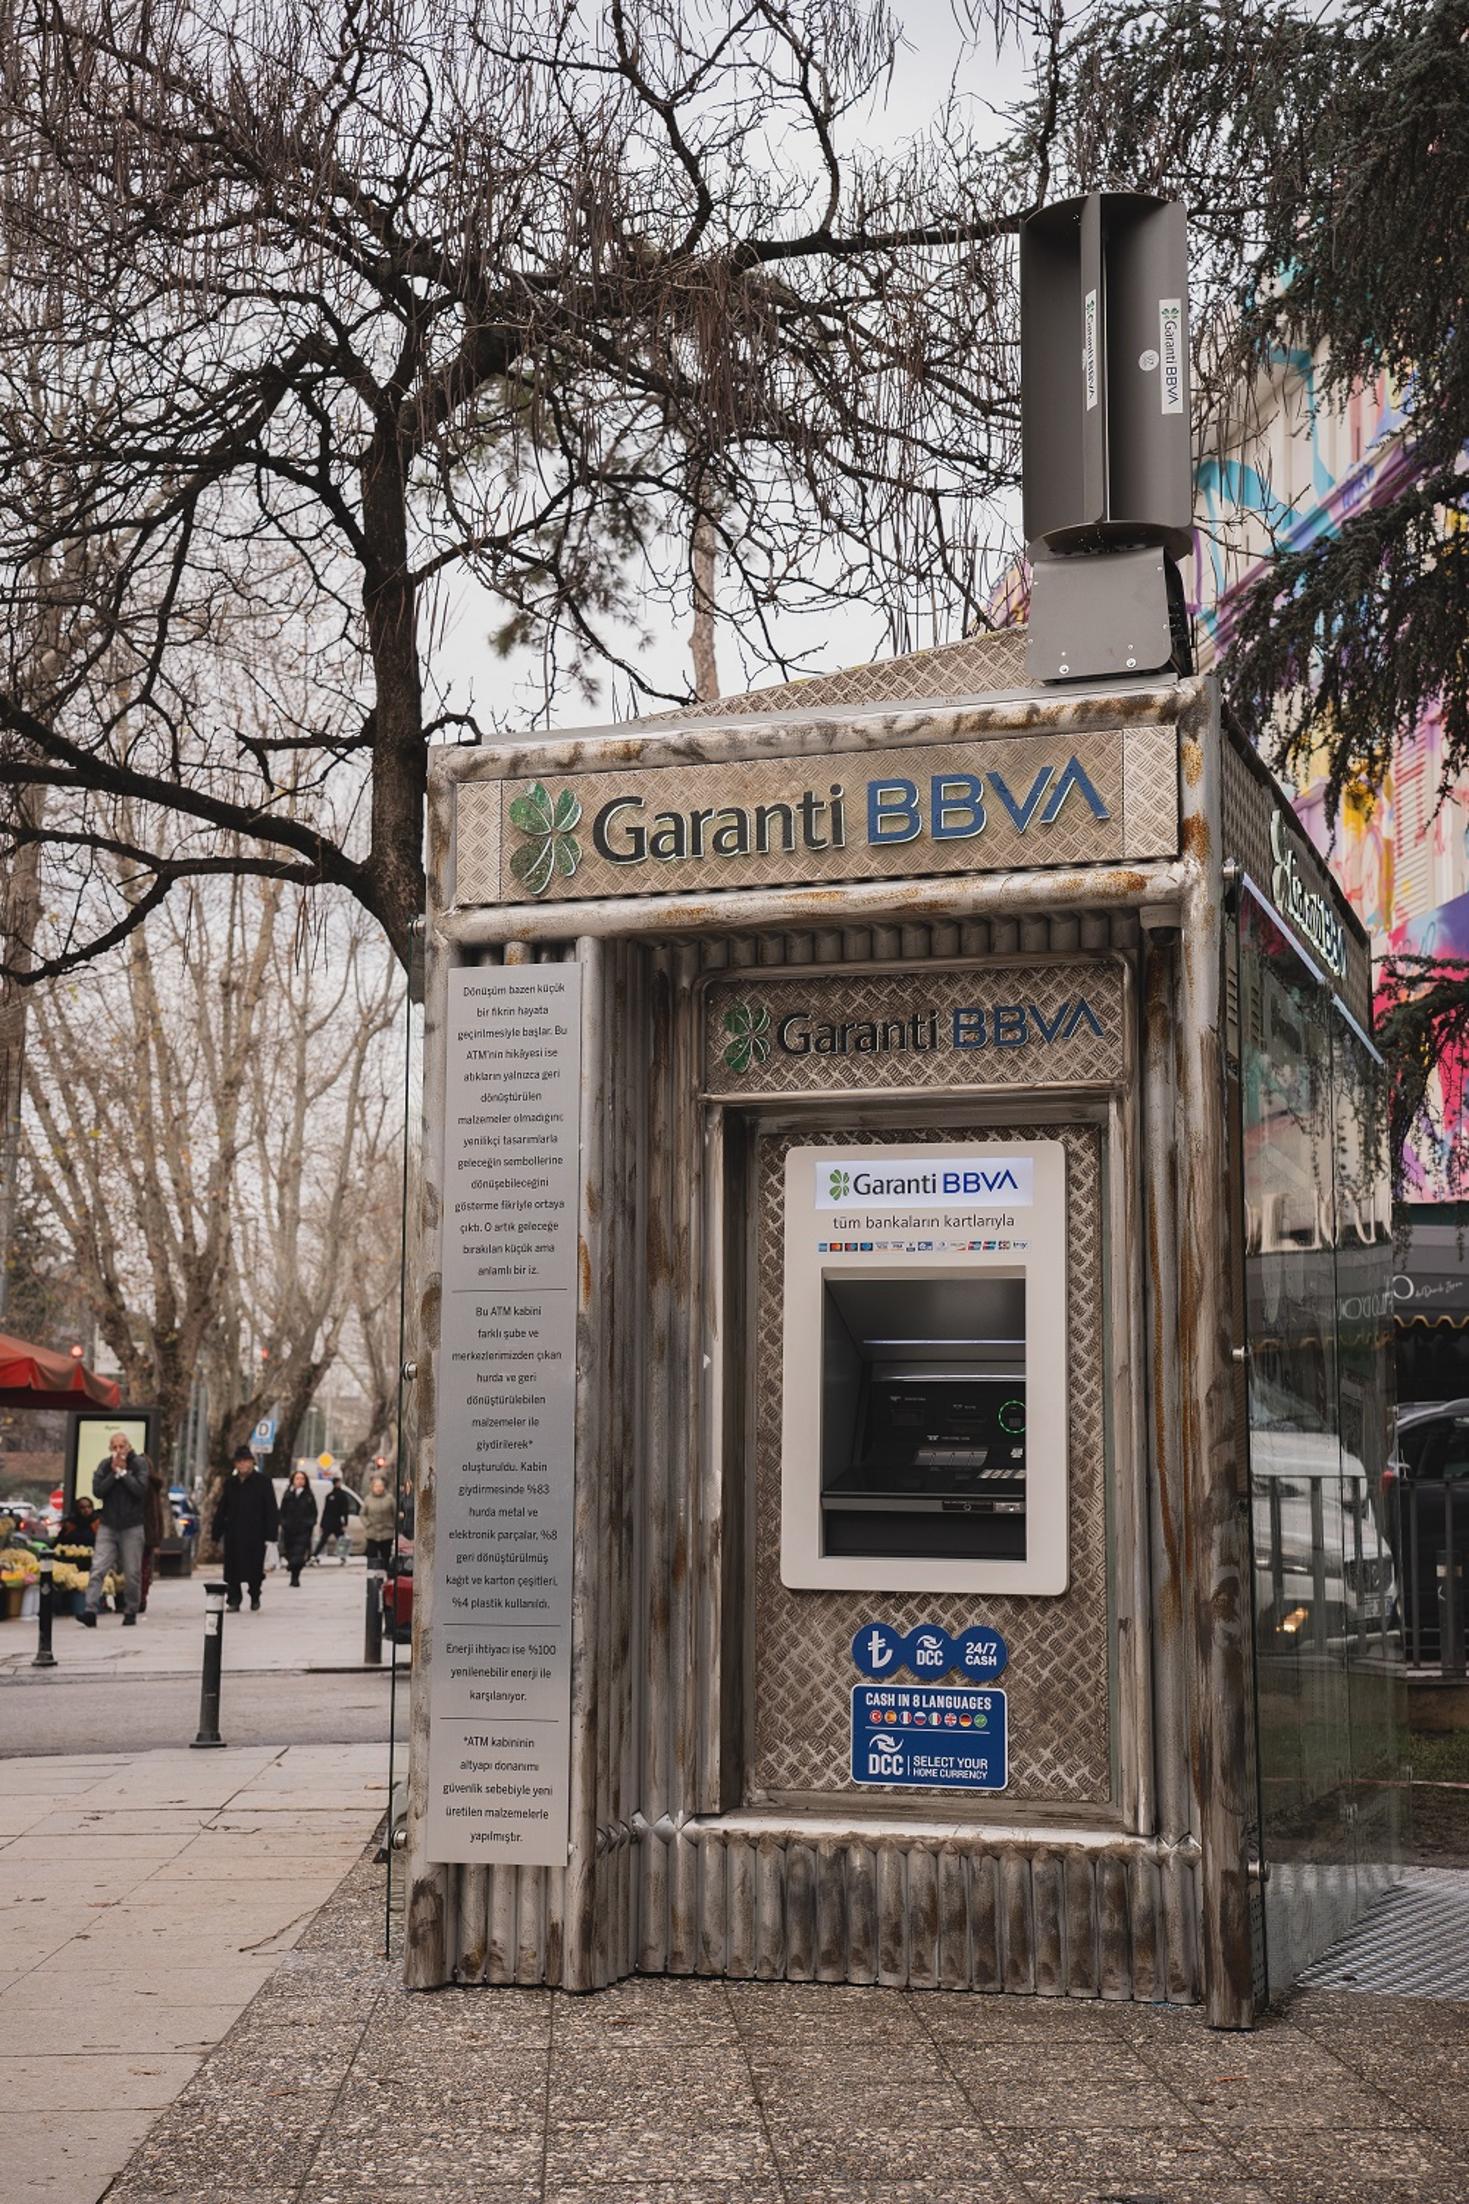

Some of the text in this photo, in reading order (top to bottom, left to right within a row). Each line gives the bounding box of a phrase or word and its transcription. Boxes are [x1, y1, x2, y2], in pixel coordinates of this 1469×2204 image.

[1164, 321, 1179, 404] Garanti BBVA
[592, 755, 1110, 865] Garanti BBVA
[464, 983, 564, 997] Dönüşüm bazen küçük
[477, 1008, 489, 1017] bir
[518, 1006, 548, 1017] hayata
[555, 1025, 567, 1035] Bu
[777, 999, 1104, 1056] Garanti BBVA
[545, 1048, 558, 1057] ise
[542, 1069, 560, 1080] geri
[480, 1091, 542, 1103] dönüştürülen
[458, 1115, 511, 1124] malzemeler
[463, 1134, 558, 1147] yenilikçi tasarımlarla
[458, 1156, 563, 1170] geleceğin sembollerine
[471, 1177, 548, 1190] dönüşebileceğini
[853, 1169, 1019, 1195] Garanti BBVA
[455, 1200, 564, 1212] gösterme fikriyle ortaya
[485, 1222, 492, 1231] O
[494, 1222, 514, 1231] artık
[518, 1222, 559, 1233] geleceğe
[833, 1213, 1014, 1230] tüm bankaların kartlarıyla
[505, 1243, 532, 1255] küçük
[535, 1244, 554, 1252] ama
[478, 1266, 512, 1275] anlamlı
[514, 1265, 526, 1274] bir
[476, 1306, 541, 1316] Bu ATM kabini
[478, 1329, 539, 1340] farklı şube ve
[452, 1351, 561, 1362] merkezlerimizden çıkan
[477, 1373, 503, 1382] hurda
[518, 1372, 536, 1384] geri
[467, 1395, 545, 1406] dönüştürülebilen
[472, 1417, 539, 1427] malzemeler ile
[462, 1462, 547, 1473] oluşturuldu. Kabin
[458, 1484, 550, 1496] giydirmesinde %83
[469, 1507, 538, 1517] hurda metal ve
[449, 1530, 495, 1539] elektronik
[541, 1530, 557, 1540] %8
[456, 1553, 548, 1565] geri dönüştürülmüş
[484, 1575, 515, 1585] karton
[452, 1598, 550, 1609] %4 plastik kullanıldı.
[446, 1644, 556, 1656] Enerji ihtiyacı ise %100
[966, 1642, 997, 1654] 24/7
[916, 1650, 943, 1666] DCC
[965, 1655, 997, 1666] CASH
[451, 1667, 551, 1680] yenilenebilir enerji ile
[470, 1690, 527, 1703] karşılanıyor.
[866, 1692, 992, 1710] CASH IN 8 LANGUAGES
[491, 1737, 534, 1748] kabininin
[460, 1760, 539, 1772] altyapı donanımı
[868, 1754, 903, 1775] DCC
[913, 1756, 988, 1769] SELECT YOUR
[913, 1769, 988, 1779] HOME CURRENCY
[443, 1783, 552, 1797] güvenlik sebebiyle yeni
[446, 1806, 549, 1819] üretilen malzemelerle
